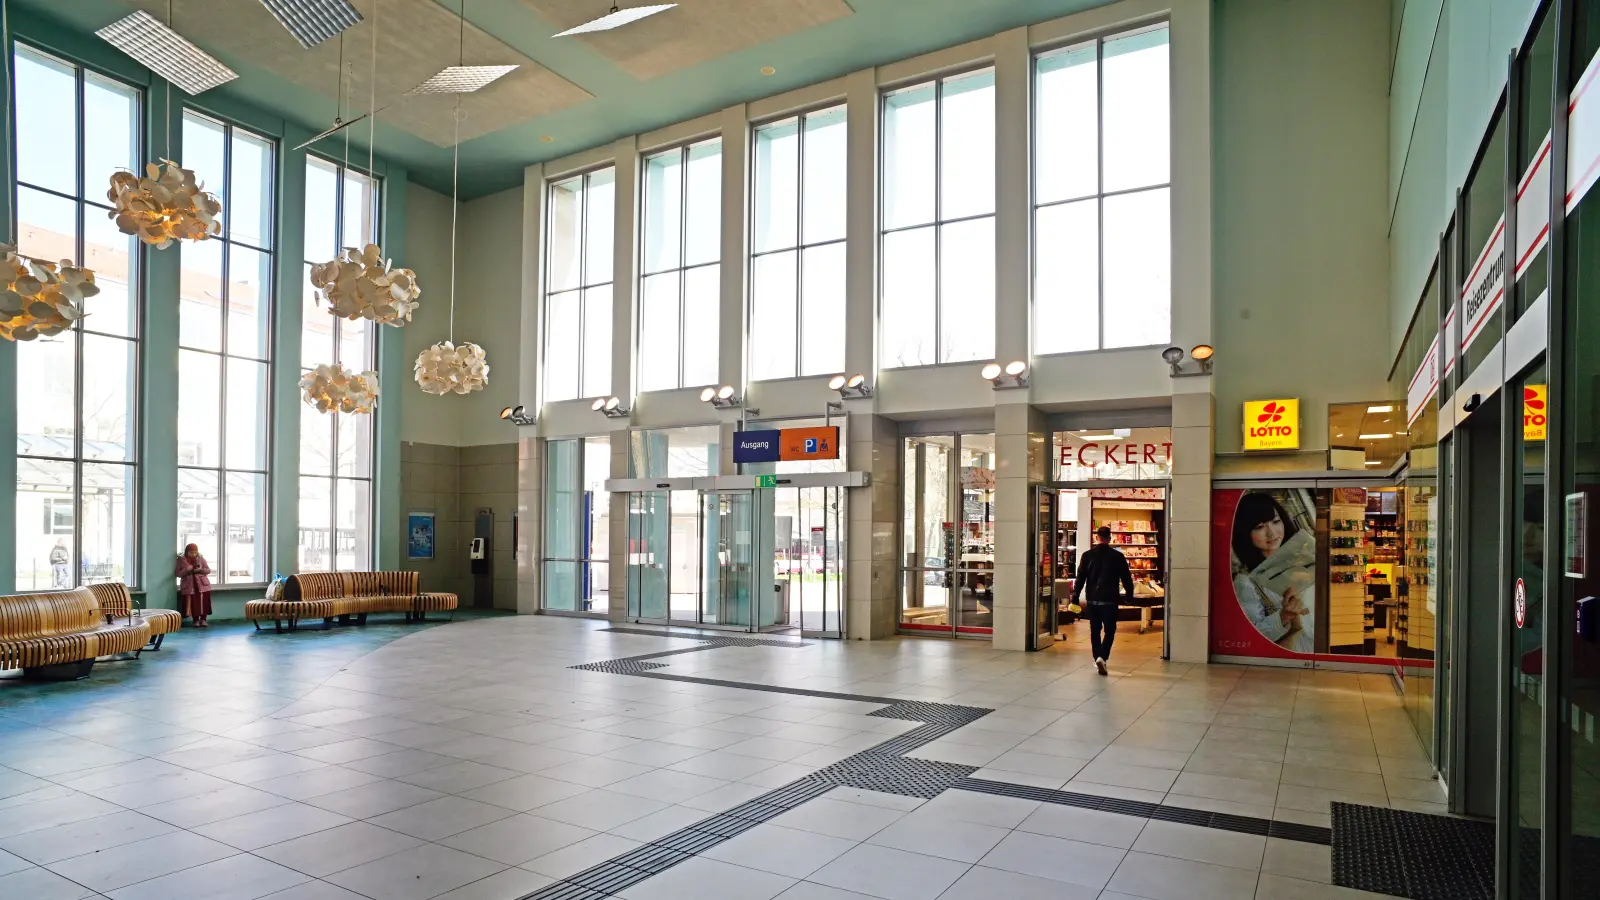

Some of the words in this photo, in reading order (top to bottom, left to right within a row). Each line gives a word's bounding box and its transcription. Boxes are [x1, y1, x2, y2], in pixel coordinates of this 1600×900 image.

[1250, 426, 1292, 437] LOTTO
[740, 441, 769, 449] Ausgang
[1061, 443, 1173, 467] ECKERT
[1219, 640, 1251, 650] ECKERT
